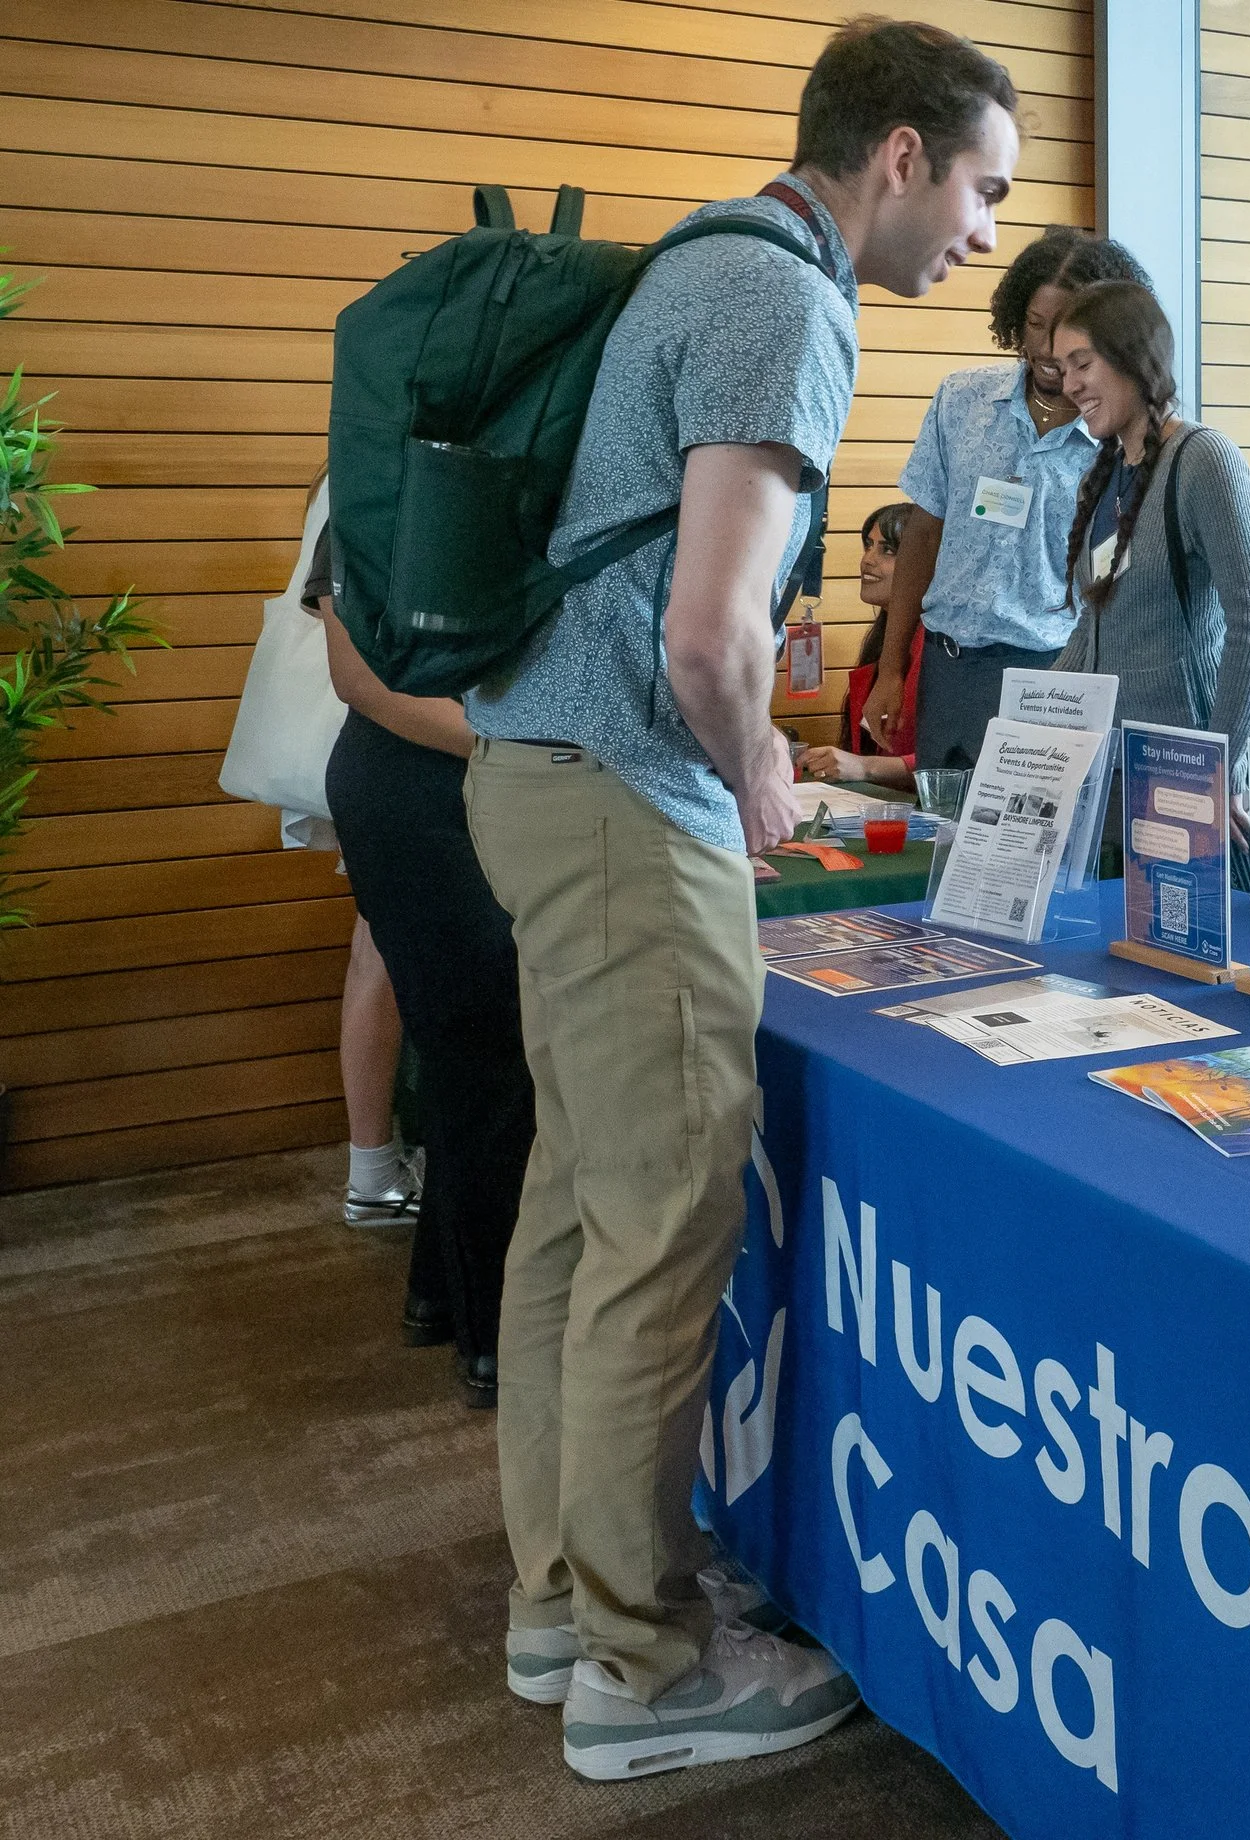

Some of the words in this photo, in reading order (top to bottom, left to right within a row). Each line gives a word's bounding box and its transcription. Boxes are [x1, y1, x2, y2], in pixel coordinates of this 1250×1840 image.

[1046, 688, 1084, 704] Ambiental
[1020, 703, 1042, 712] Eventos
[1048, 706, 1084, 716] Actividades
[999, 742, 1048, 756] Environmental
[1047, 746, 1070, 762] Justice
[1142, 744, 1161, 761] Stay
[1162, 748, 1206, 766] Informed!
[1000, 756, 1020, 767] Events
[1026, 761, 1065, 772] Opportunities
[980, 782, 1005, 792] Internship
[977, 790, 1006, 802] Opportunity
[1002, 814, 1028, 825] BAYSHORE
[1029, 817, 1054, 828] LIMPIEZAS
[1161, 932, 1174, 942] SCAN
[1175, 934, 1187, 945] HERE
[1130, 1000, 1210, 1032] NOTICIAS
[831, 1411, 1119, 1795] Casa
